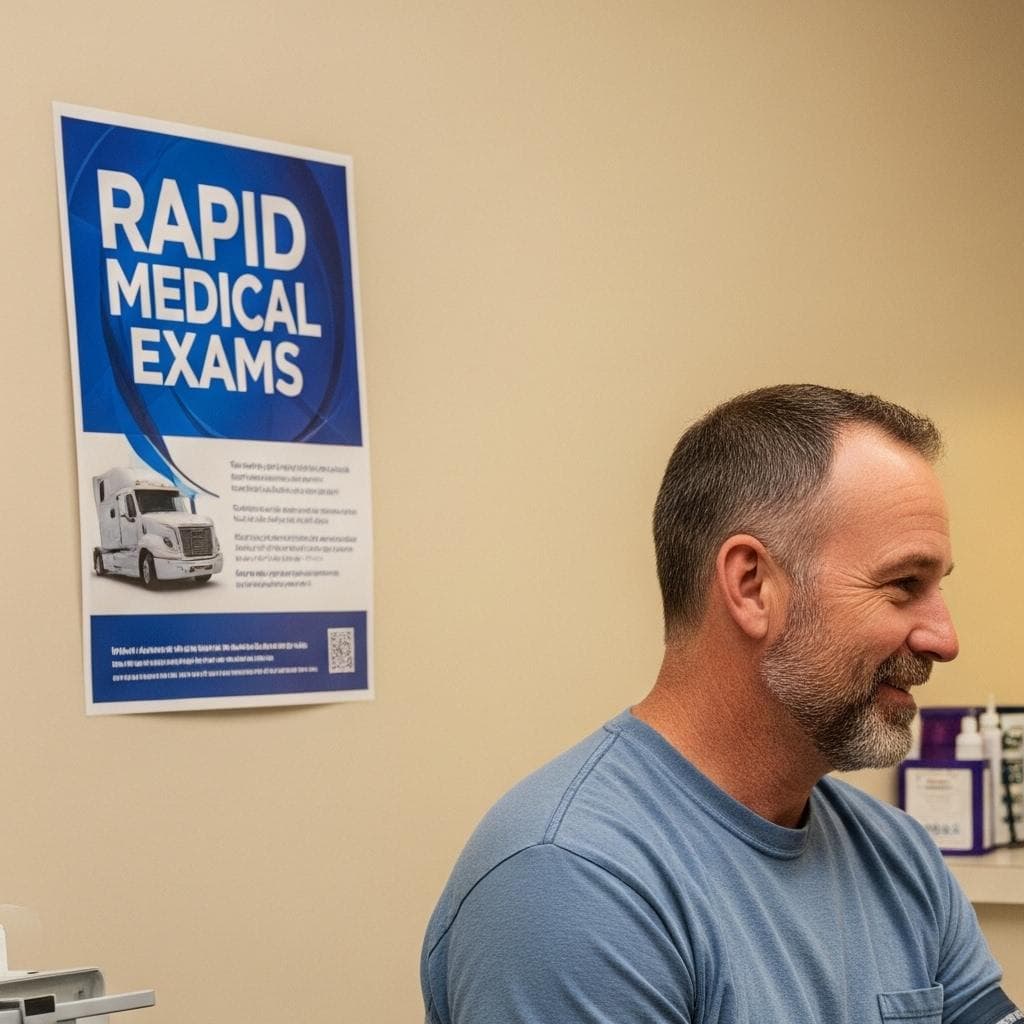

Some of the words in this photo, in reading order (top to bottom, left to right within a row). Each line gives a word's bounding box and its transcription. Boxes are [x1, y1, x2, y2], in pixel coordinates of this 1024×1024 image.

[97, 168, 306, 272] RAPID
[106, 257, 322, 338] MEDICAL
[130, 326, 304, 398] EXAMS
